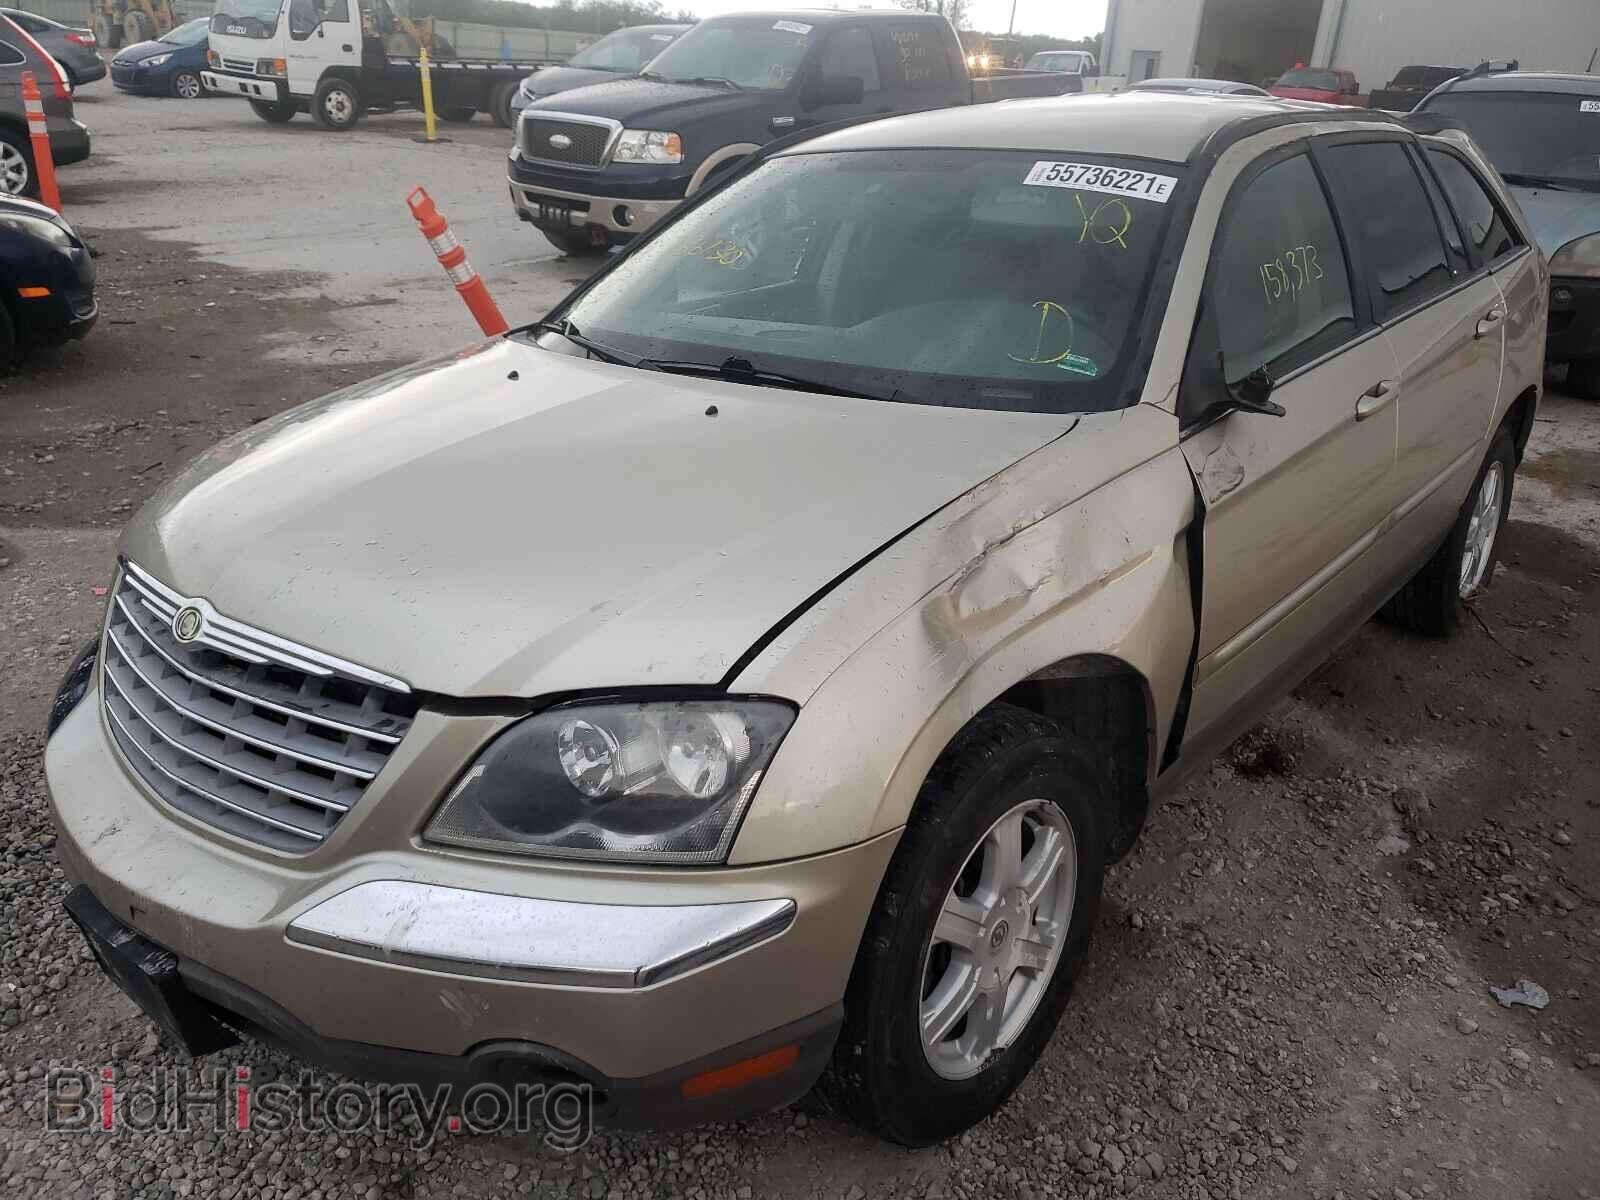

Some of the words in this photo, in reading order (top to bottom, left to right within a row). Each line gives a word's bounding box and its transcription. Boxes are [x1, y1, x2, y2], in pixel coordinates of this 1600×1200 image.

[225, 24, 247, 34] ISUZU
[1045, 163, 1157, 194] 55736221
[1074, 192, 1132, 249] YQ
[1007, 300, 1074, 364] D
